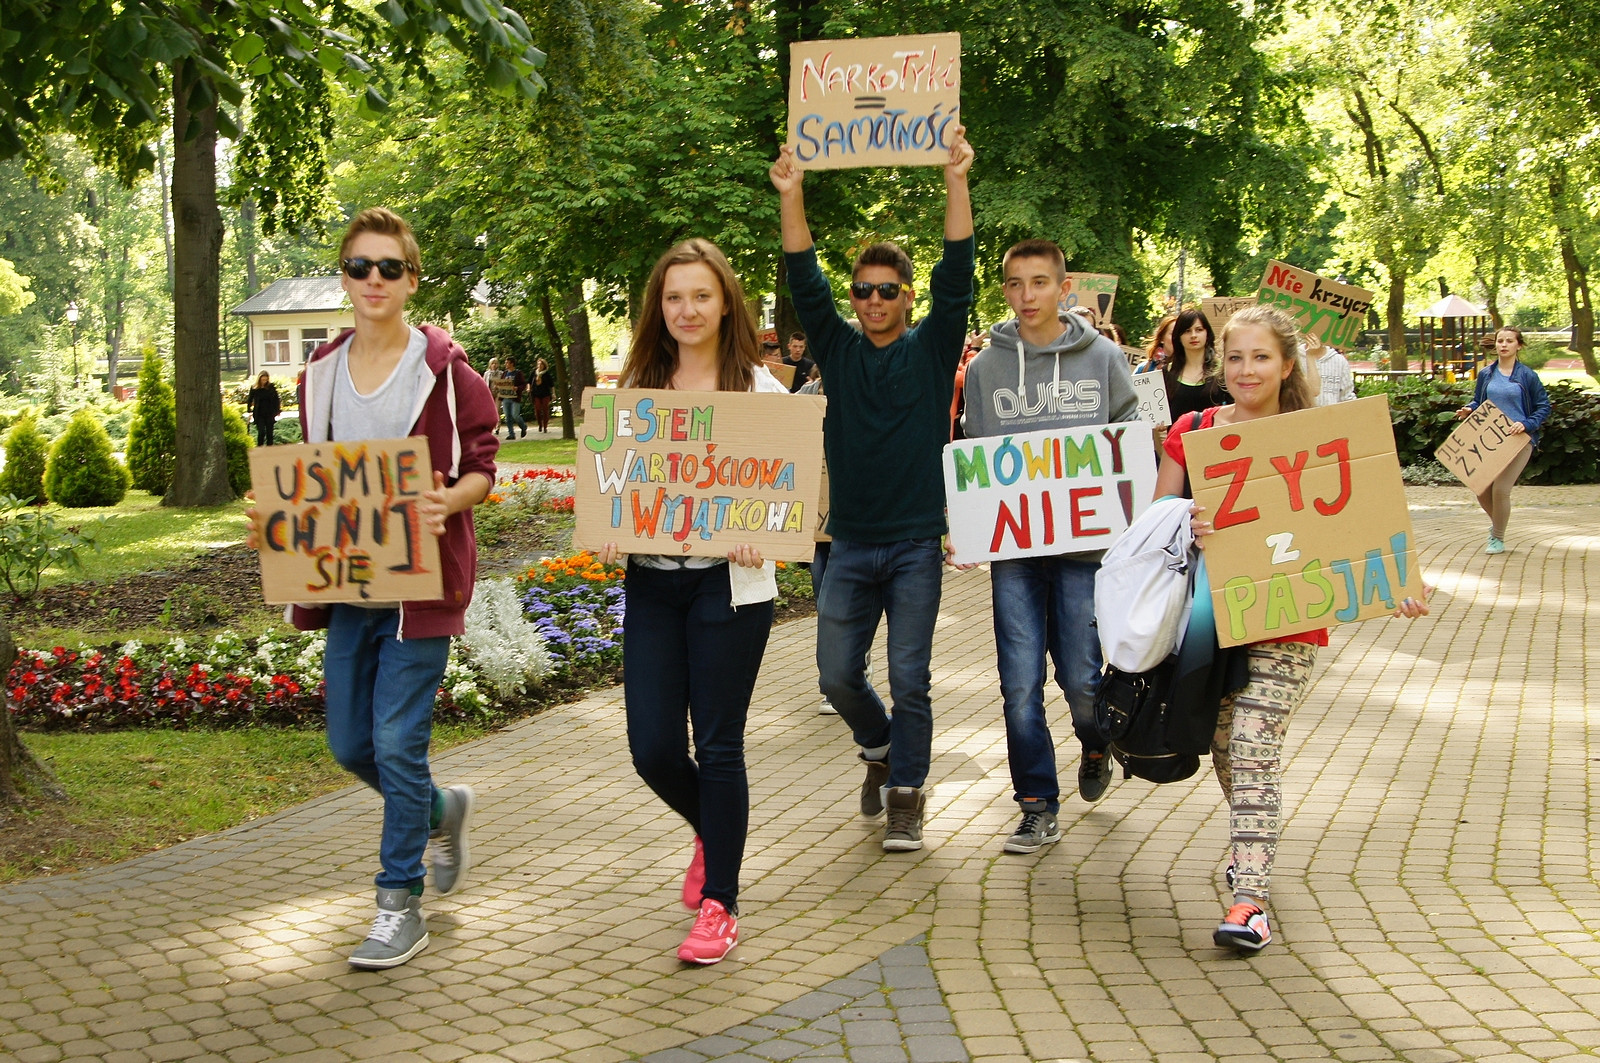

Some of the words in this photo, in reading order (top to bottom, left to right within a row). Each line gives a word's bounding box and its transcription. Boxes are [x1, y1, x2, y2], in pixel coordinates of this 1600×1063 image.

[796, 103, 959, 161] SAMOTNOŚĆ
[1267, 265, 1303, 293] Nie
[584, 394, 714, 452] JESTEM
[1464, 402, 1496, 431] TRWA
[594, 444, 795, 495] WARTOŚCIOWA
[953, 427, 1127, 491] MÓWIMY
[1204, 434, 1351, 530] ŻYJ
[611, 496, 622, 528] I
[631, 487, 804, 542] WYJĄTKOWA
[306, 546, 375, 600] SIĘ
